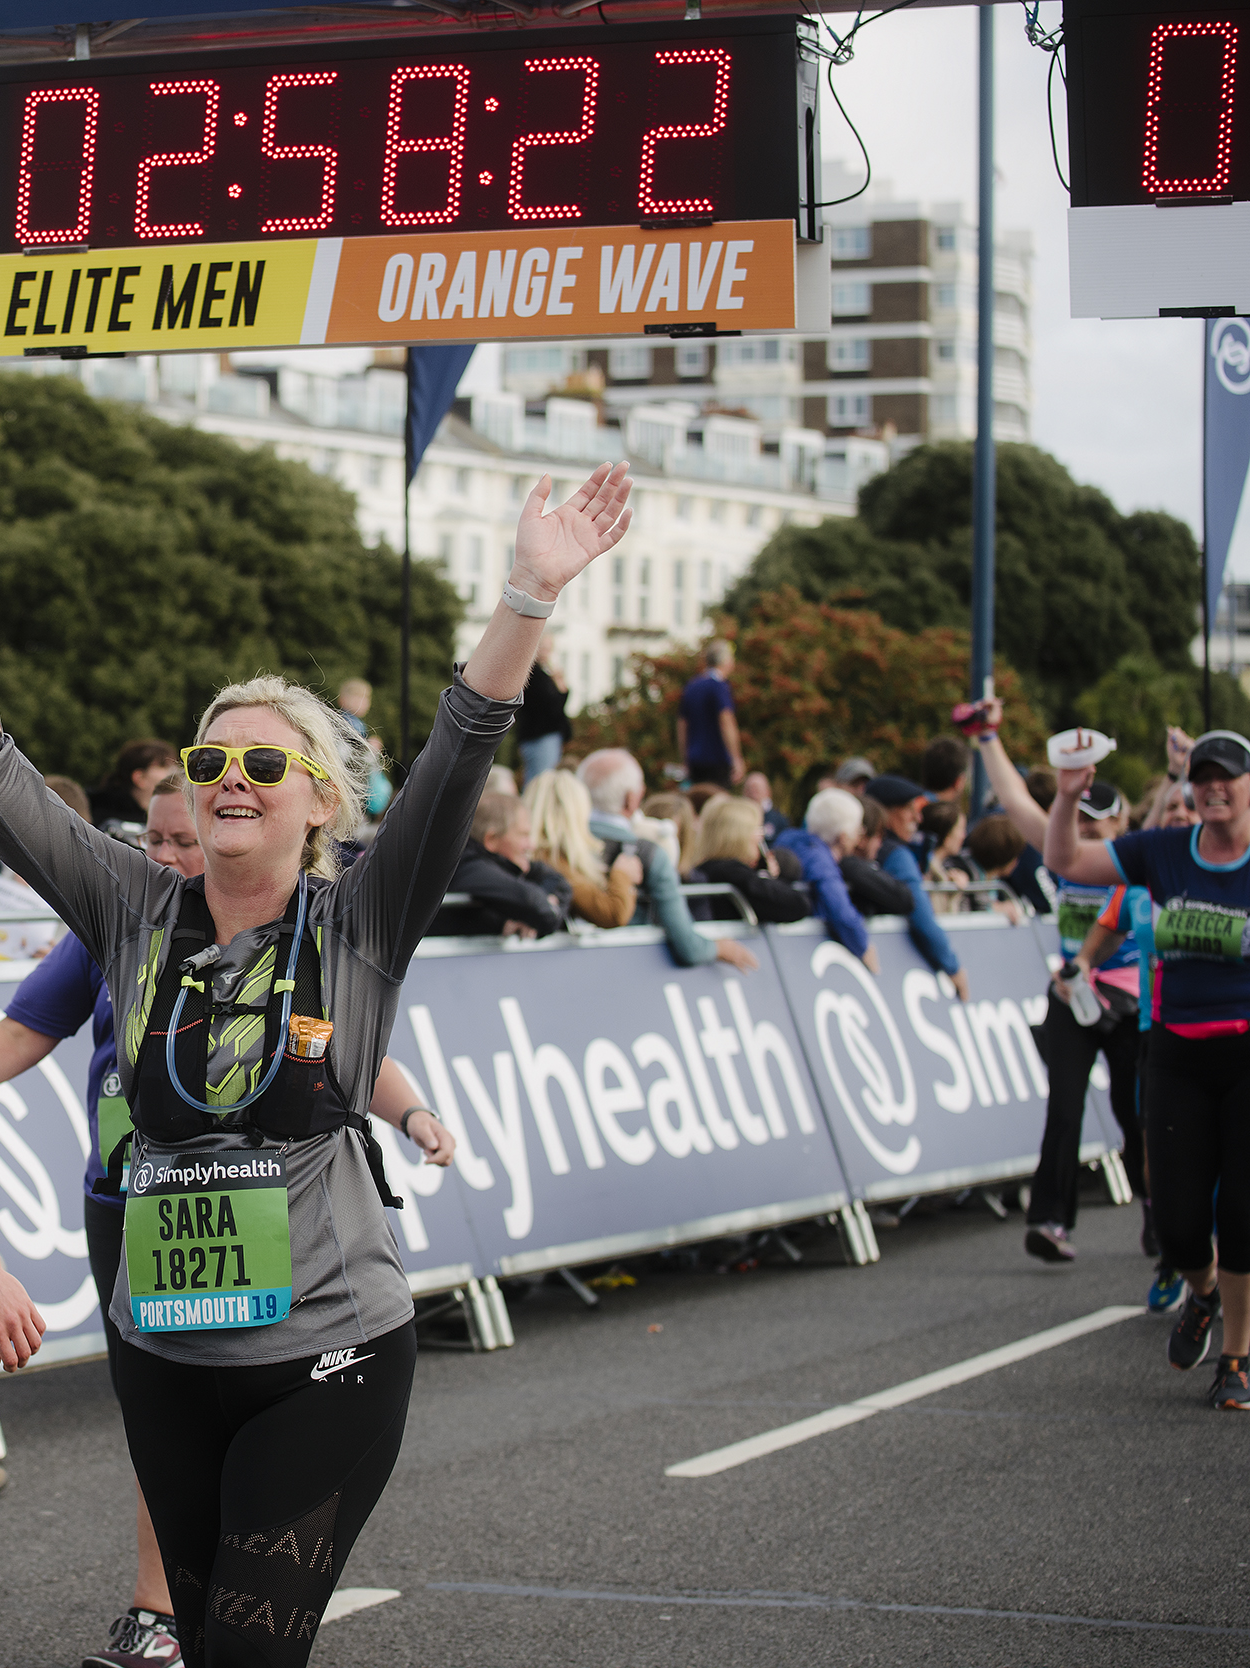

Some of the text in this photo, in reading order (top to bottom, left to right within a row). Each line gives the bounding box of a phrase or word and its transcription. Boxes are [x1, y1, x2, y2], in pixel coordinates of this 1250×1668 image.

[15, 48, 732, 243] 02:58:22
[3, 260, 266, 337] ELITE MEN
[377, 239, 754, 322] ORANGE WAVE
[155, 1159, 281, 1187] Simplyhealth
[158, 1195, 238, 1241] SARA
[152, 1245, 251, 1291] 18271
[139, 1294, 277, 1328] PORTSMOUTH 19
[319, 1348, 357, 1368] NIKE
[319, 1374, 365, 1384] AIR
